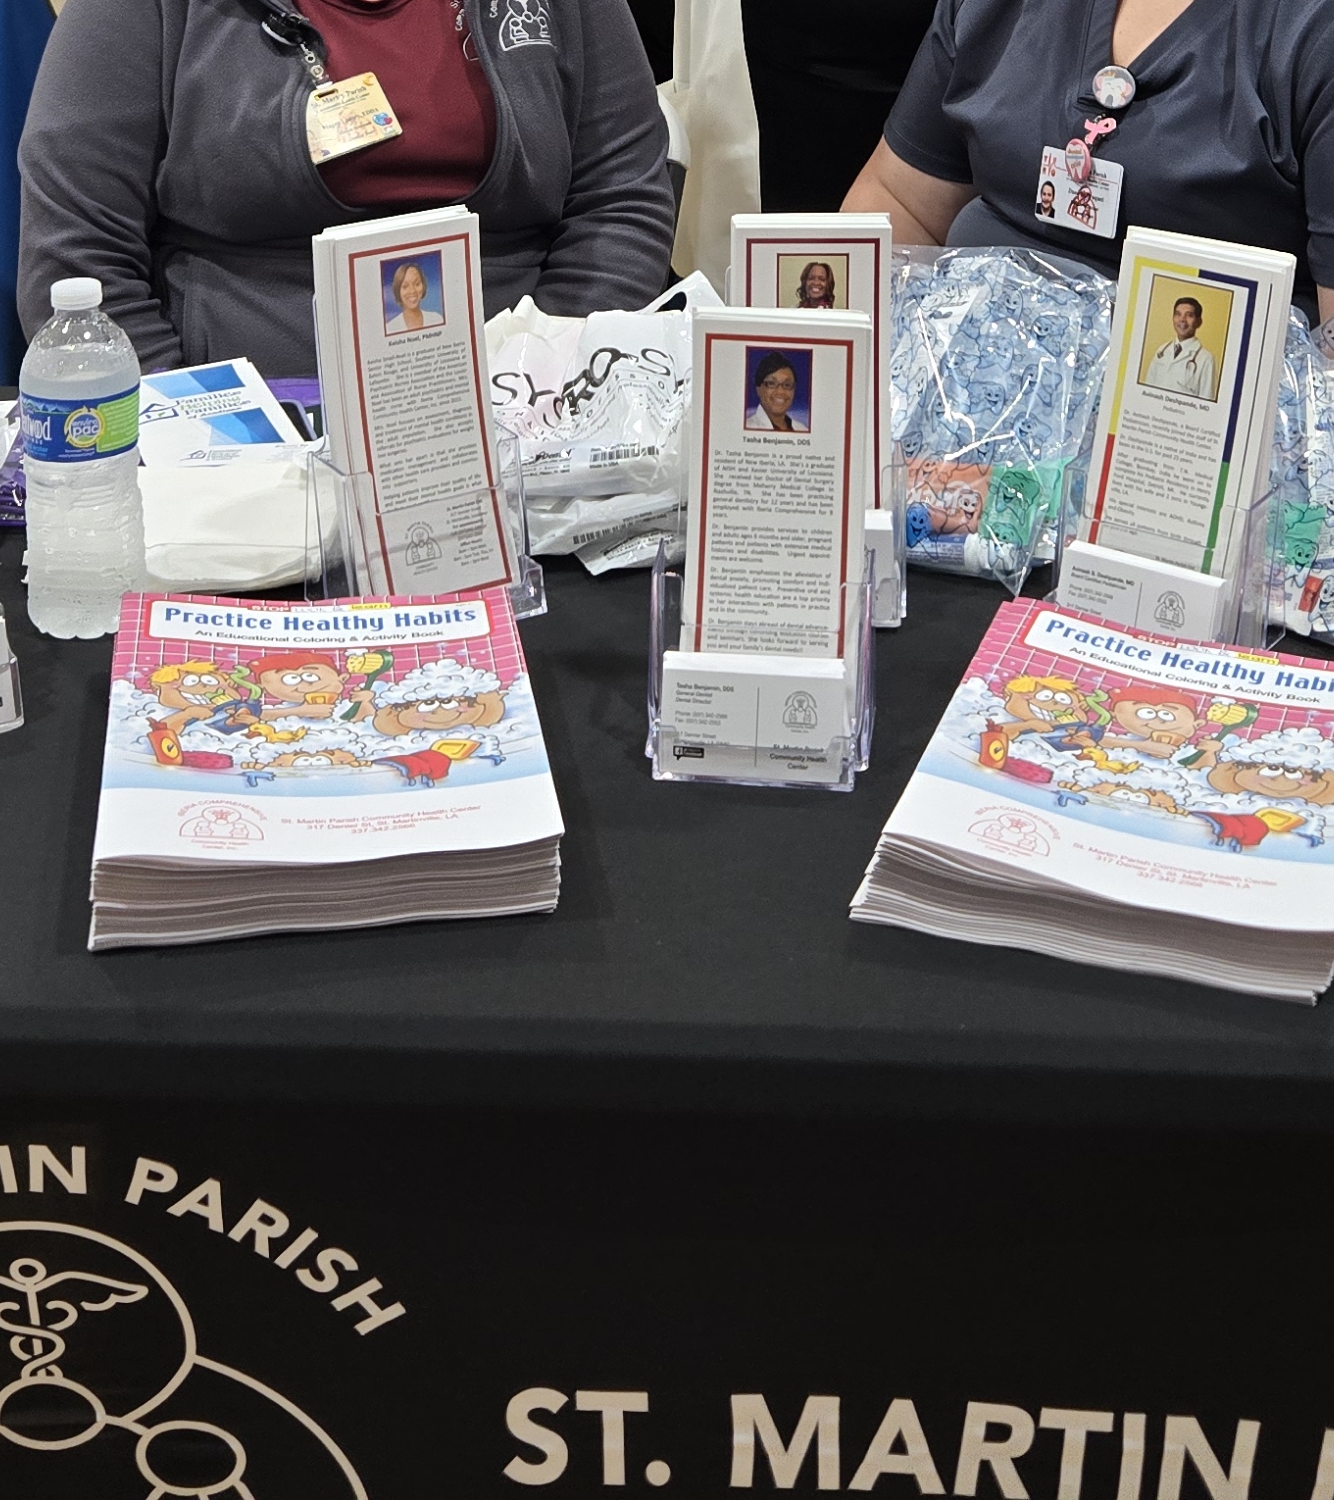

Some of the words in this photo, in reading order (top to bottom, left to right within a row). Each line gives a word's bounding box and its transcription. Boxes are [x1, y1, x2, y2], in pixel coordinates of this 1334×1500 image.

[175, 390, 243, 405] Families
[1164, 395, 1199, 411] Deshpande,
[184, 399, 252, 416] Families
[72, 424, 101, 439] pac
[742, 435, 762, 444] Tasha
[763, 436, 796, 447] Benjamin,
[165, 606, 272, 631] Practice
[283, 614, 385, 633] Healthy
[393, 608, 477, 628] Habits
[194, 630, 213, 638] An
[216, 631, 290, 643] Educational
[292, 635, 346, 644] Coloring
[360, 631, 408, 642] Activity
[411, 630, 444, 638] Book
[1136, 634, 1175, 647] STOP
[1045, 619, 1153, 661] Practice
[1160, 652, 1266, 686] Healthy
[1069, 646, 1087, 656] An
[1089, 652, 1163, 678] Educational
[1164, 673, 1219, 689] Coloring
[1221, 683, 1232, 691] &
[1234, 685, 1283, 701] Activity
[1285, 694, 1321, 704] Book
[769, 752, 807, 764] Community
[361, 811, 416, 822] Community
[416, 808, 448, 818] Health
[449, 804, 482, 814] Center
[123, 1156, 407, 1337] PARISH
[501, 1386, 672, 1487] ST.
[727, 1391, 1263, 1500] MARTIN
